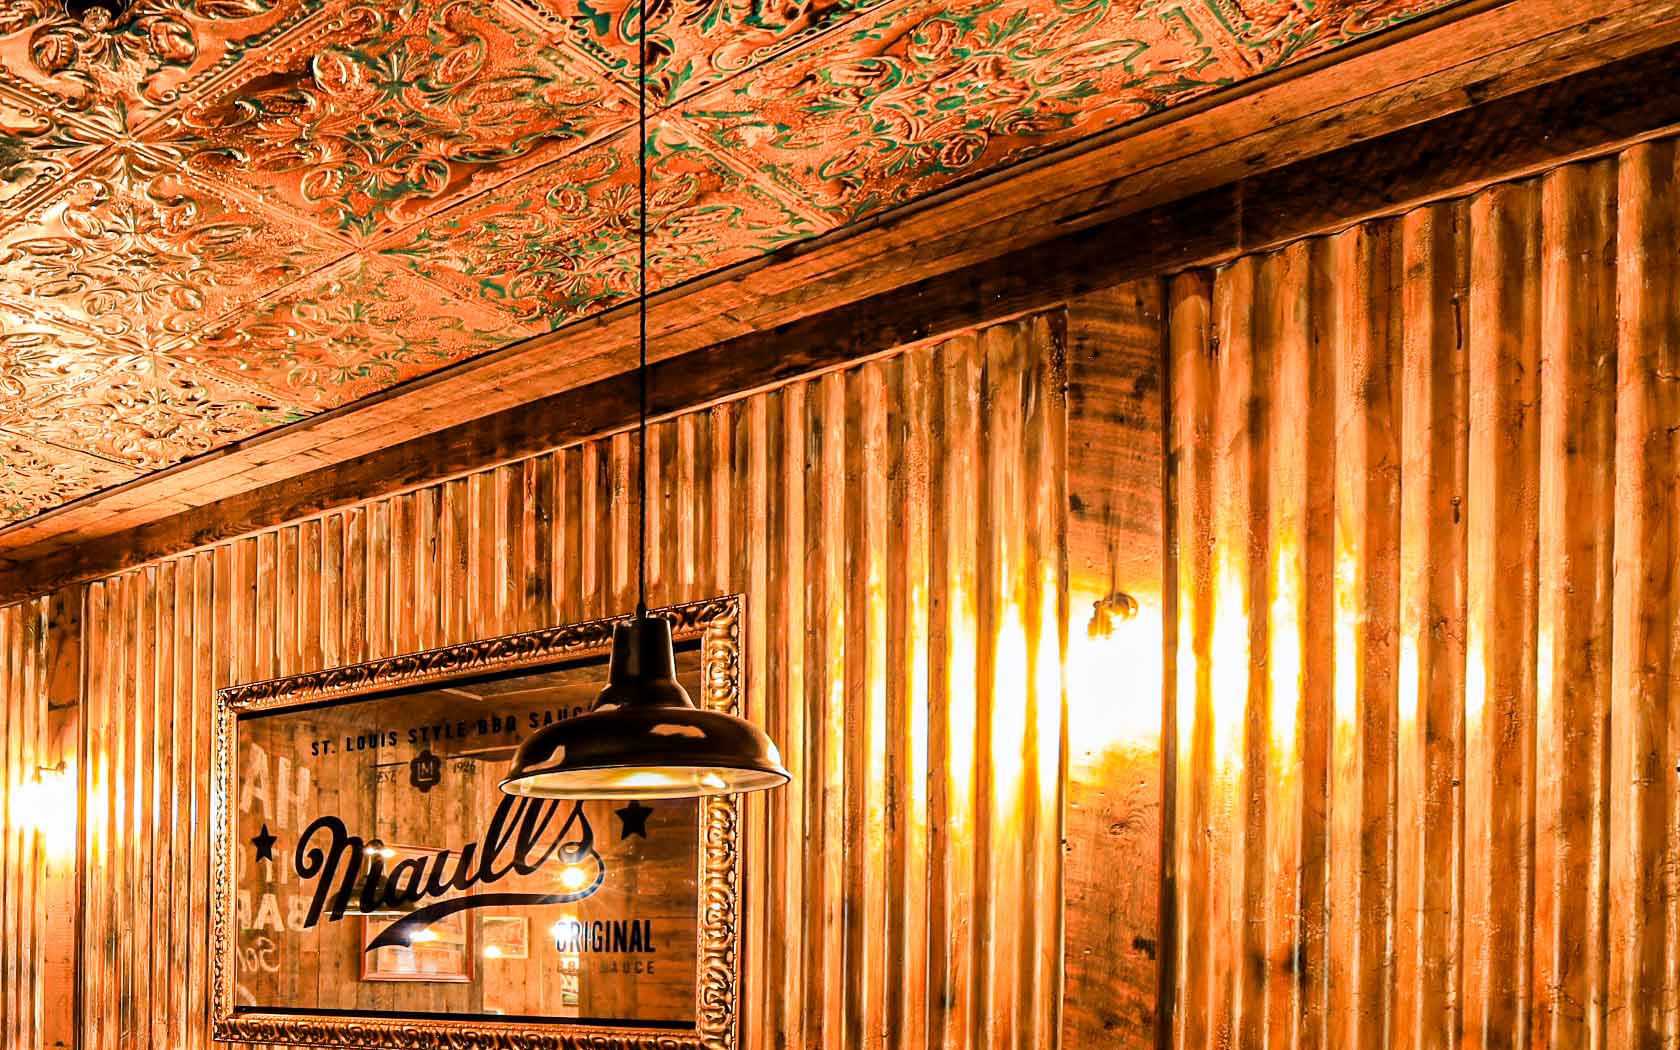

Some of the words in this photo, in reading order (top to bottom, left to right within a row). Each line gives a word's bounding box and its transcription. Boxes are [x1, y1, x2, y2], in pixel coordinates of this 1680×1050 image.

[311, 739, 337, 757] ST.
[346, 731, 398, 752] LOUIS
[408, 721, 466, 744] STYLE
[477, 715, 517, 736] BBQ
[528, 704, 595, 729] SAUC
